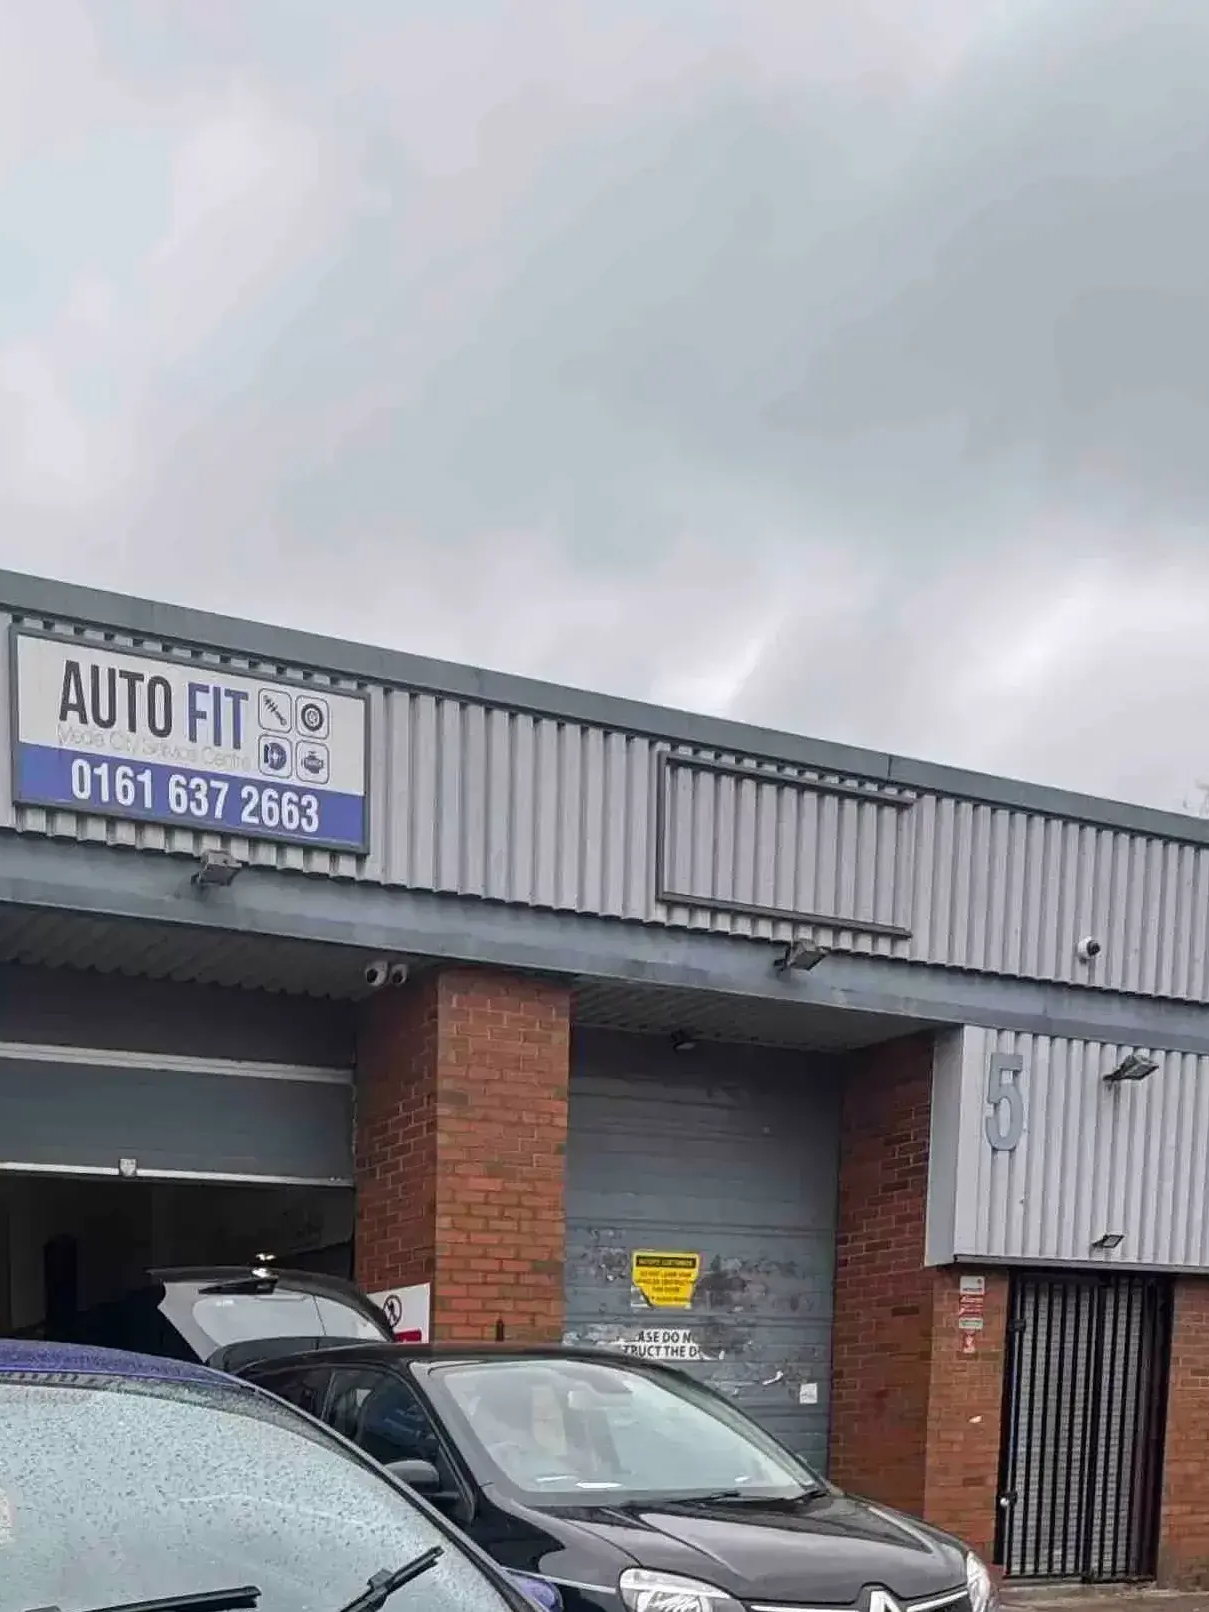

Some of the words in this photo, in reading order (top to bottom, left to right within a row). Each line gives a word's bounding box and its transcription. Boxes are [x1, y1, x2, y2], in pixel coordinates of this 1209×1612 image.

[59, 660, 172, 738] AUTO
[188, 682, 249, 750] FIT
[71, 758, 153, 809] 0161
[168, 774, 229, 819] 637
[241, 785, 319, 833] 2663
[984, 1053, 1024, 1151] 5
[663, 1345, 686, 1358] THE
